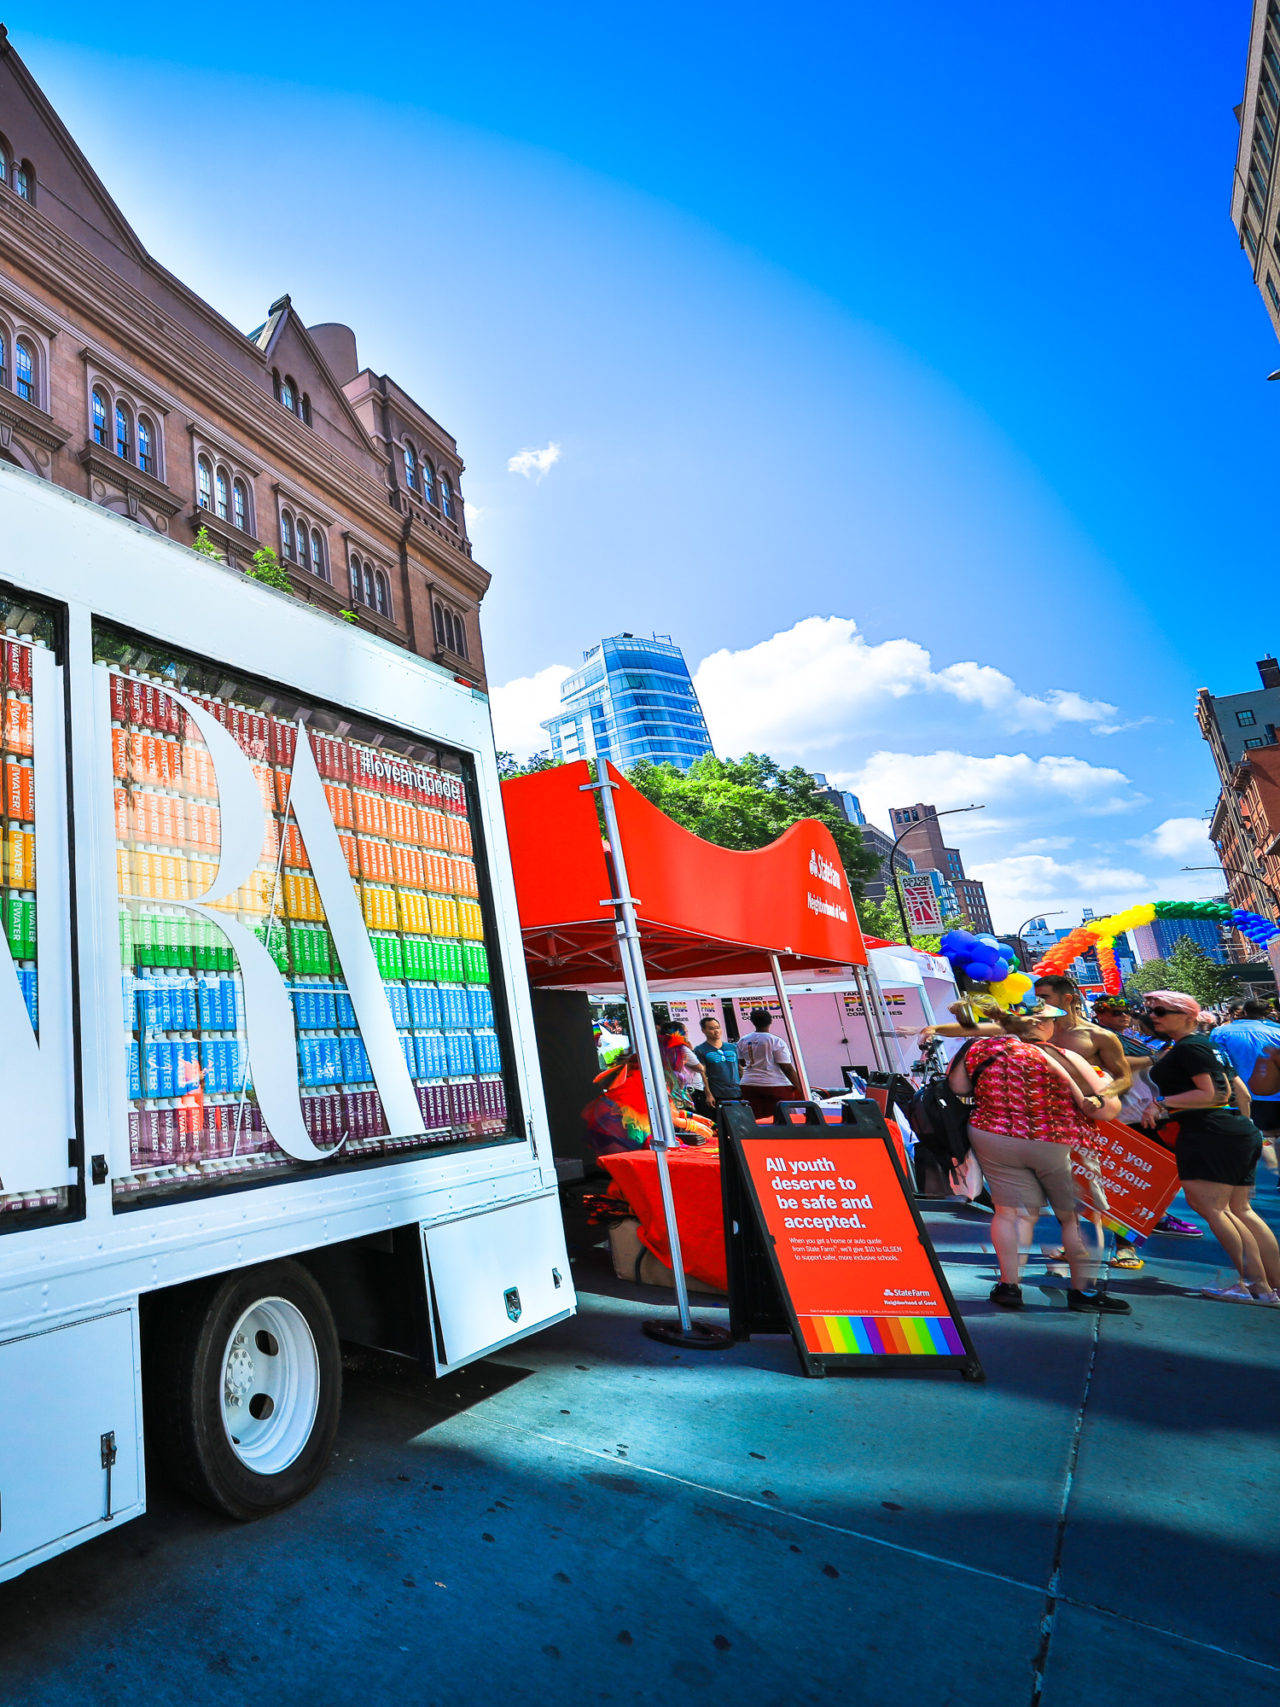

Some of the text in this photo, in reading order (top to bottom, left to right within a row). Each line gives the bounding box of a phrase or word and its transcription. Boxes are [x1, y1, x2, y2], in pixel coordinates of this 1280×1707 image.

[116, 678, 124, 704] WATER
[118, 737, 126, 770] WATER
[362, 750, 461, 799] #loveandpride
[130, 1050, 139, 1091] WATER
[130, 1122, 139, 1153] WATER
[220, 1114, 228, 1143] WATER
[766, 1157, 836, 1175] All youth
[1111, 1140, 1153, 1173] is you
[771, 1176, 857, 1190] deserve to
[1102, 1156, 1116, 1170] is
[1116, 1167, 1152, 1190] your
[776, 1194, 873, 1209] be safe and
[784, 1213, 866, 1232] accepted.
